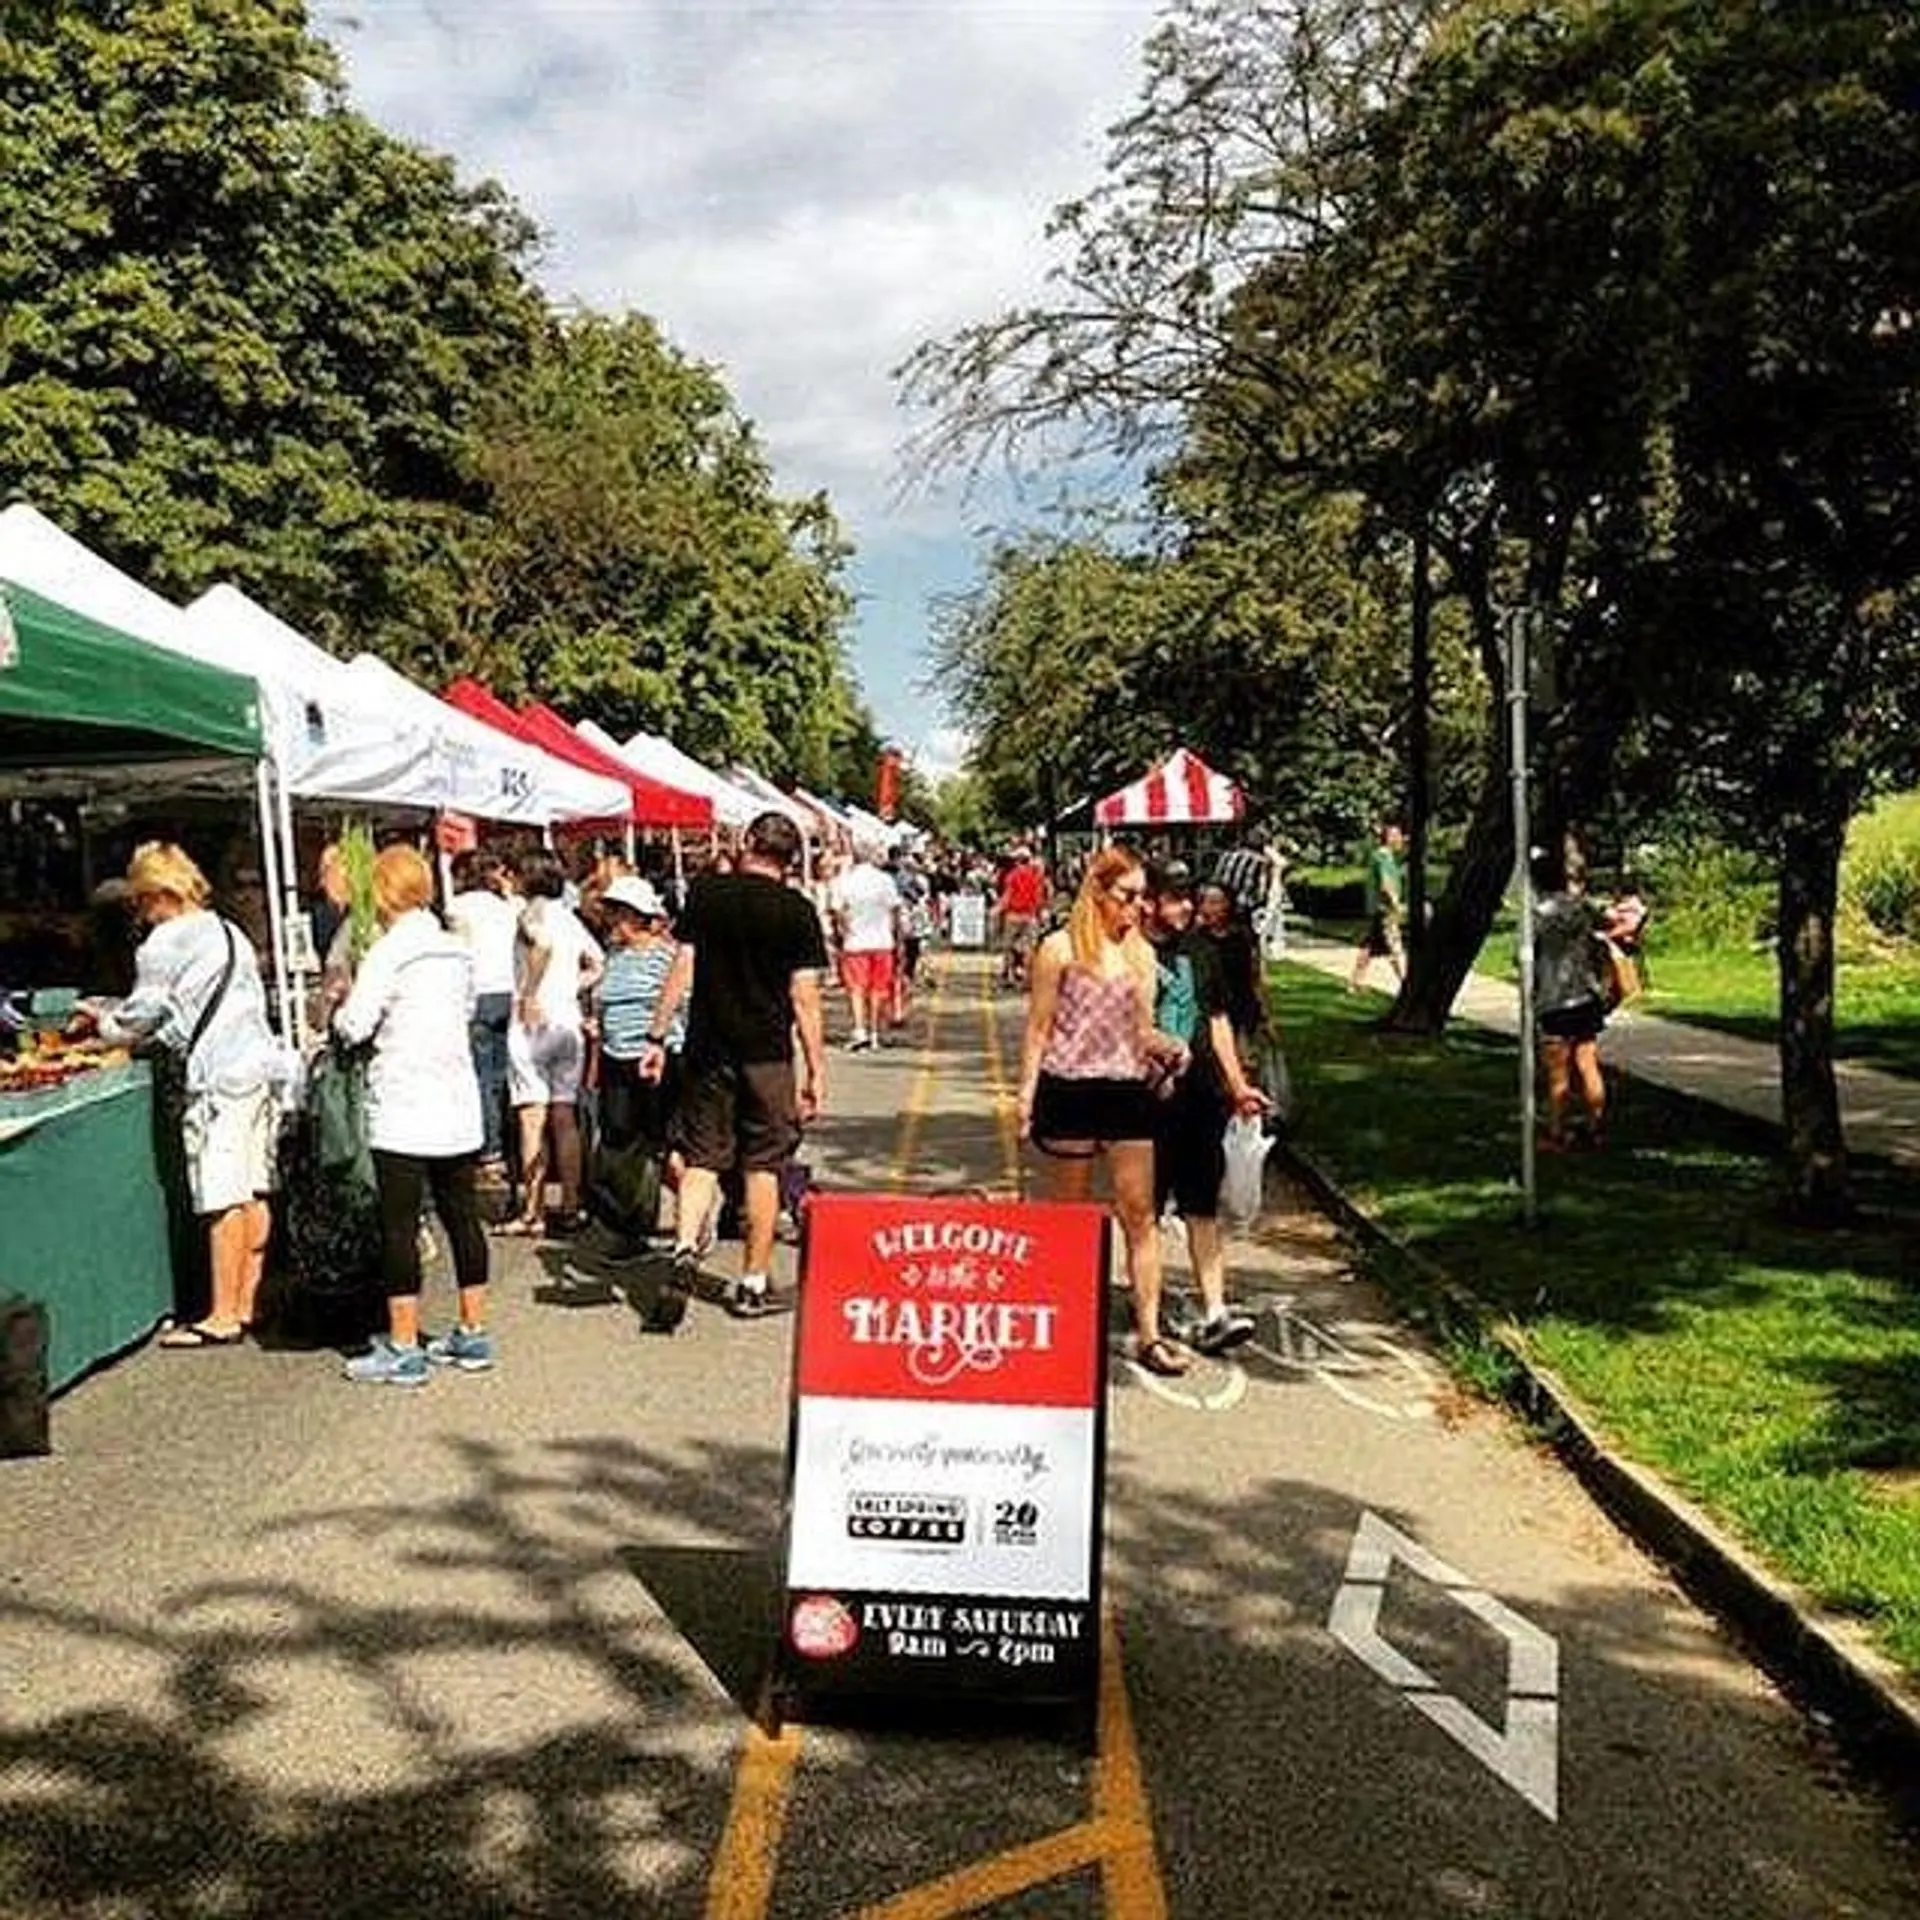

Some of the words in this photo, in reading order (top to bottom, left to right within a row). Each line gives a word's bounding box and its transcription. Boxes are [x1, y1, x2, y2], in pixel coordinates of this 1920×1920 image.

[874, 1223, 1032, 1263] WELCOME
[843, 1298, 1057, 1384] MARKET
[851, 1518, 960, 1539] COFFEE
[995, 1500, 1038, 1528] 20
[863, 1603, 947, 1630] EVERY
[952, 1608, 1085, 1638] SATURDAY
[997, 1636, 1055, 1666] 2pm
